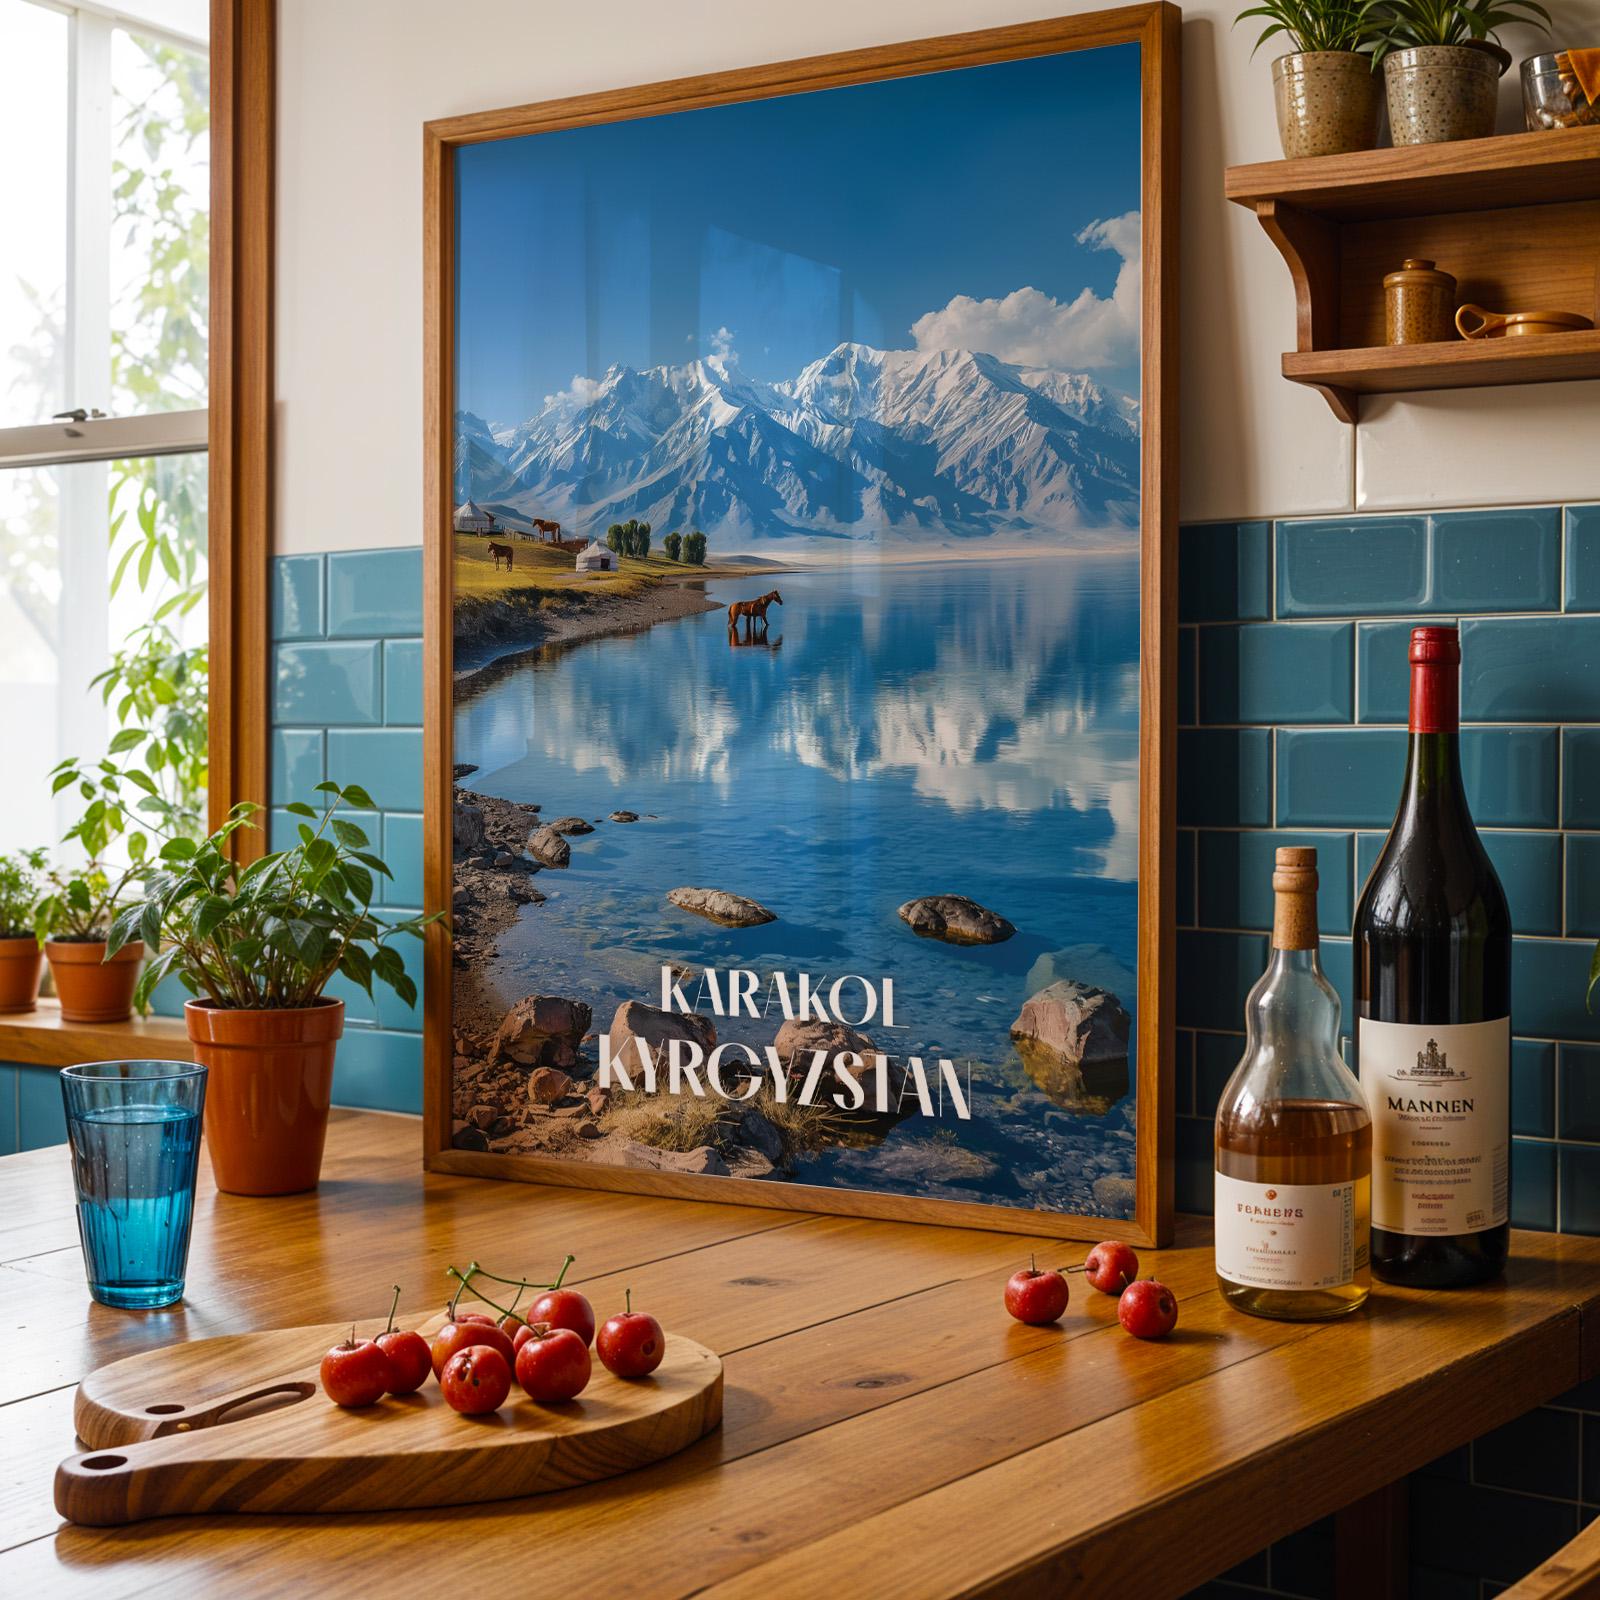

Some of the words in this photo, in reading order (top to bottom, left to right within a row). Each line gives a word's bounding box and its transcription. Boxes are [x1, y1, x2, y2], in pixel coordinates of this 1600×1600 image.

[661, 965, 910, 1029] KARAKOL
[599, 1033, 971, 1120] KYRGYZSTAN
[1387, 1096, 1475, 1113] MANNEN
